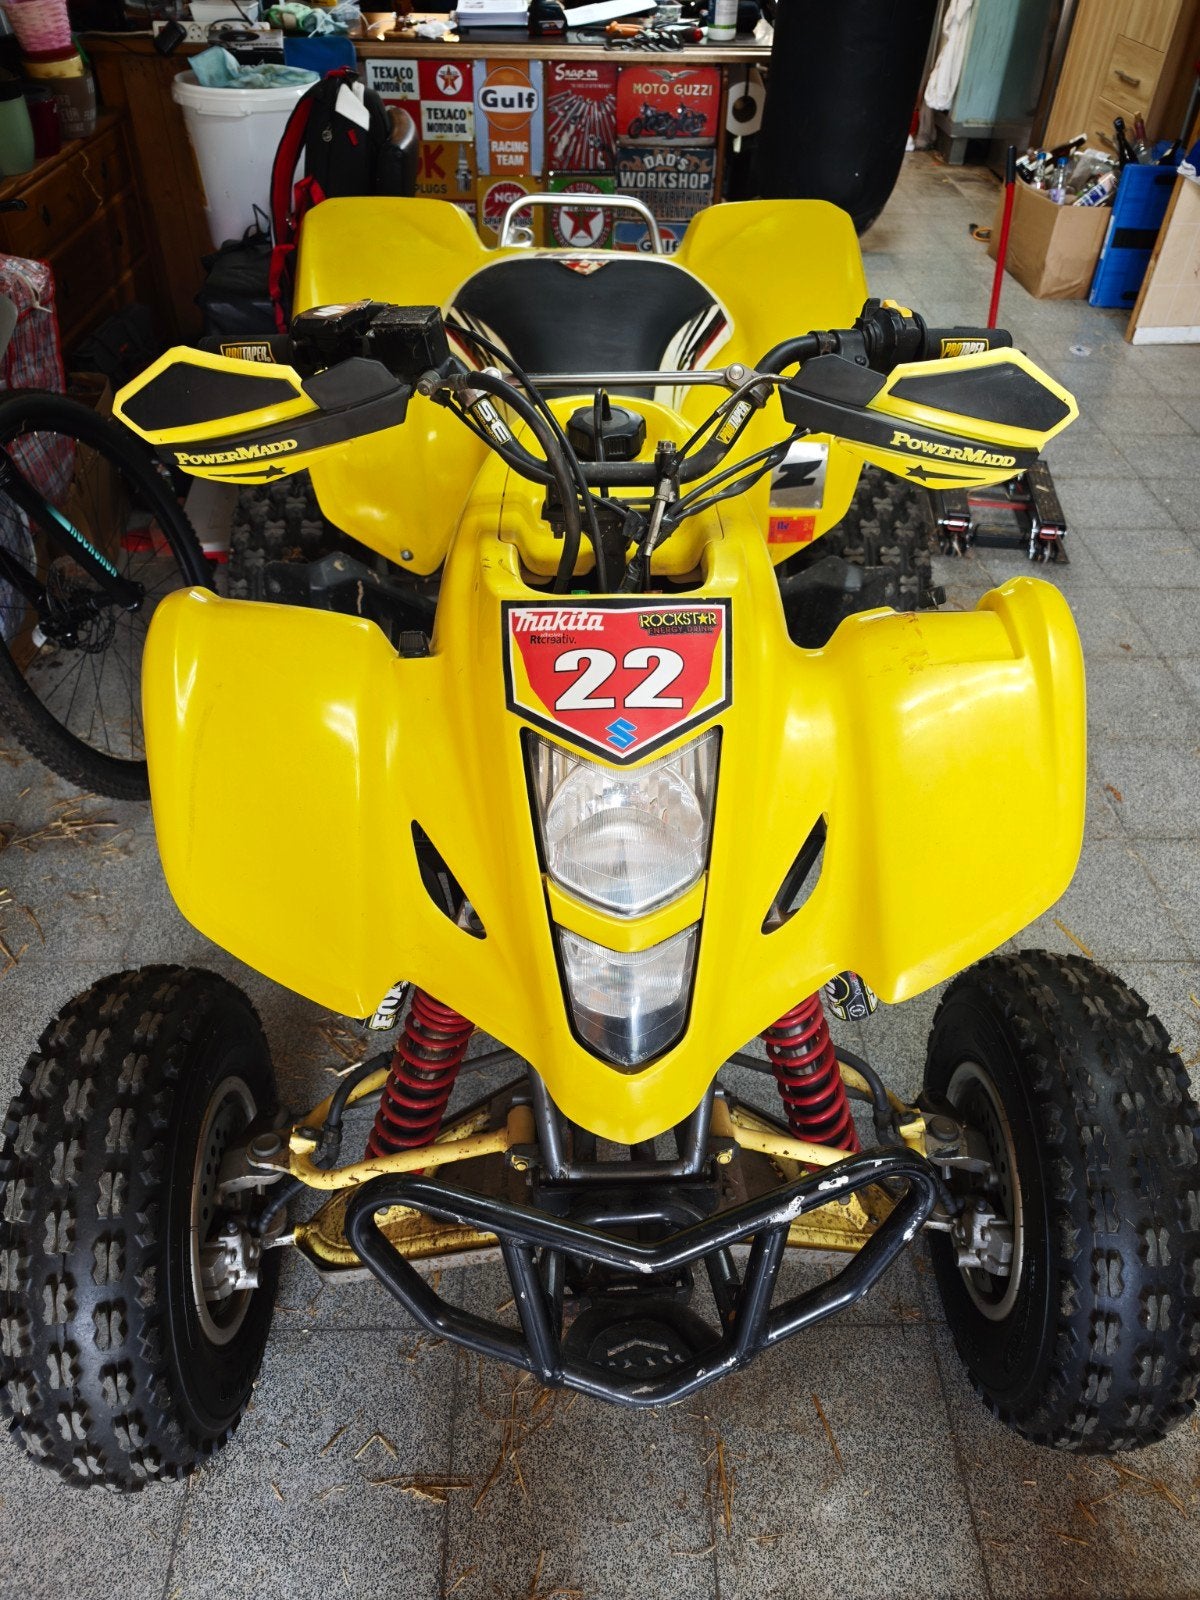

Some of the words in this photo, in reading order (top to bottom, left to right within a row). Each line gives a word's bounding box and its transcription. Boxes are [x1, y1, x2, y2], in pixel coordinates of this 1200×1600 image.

[372, 66, 414, 79] TEXACO
[555, 63, 598, 80] Snap-on
[374, 81, 400, 92] MOTOR
[402, 82, 415, 93] OIL
[633, 83, 670, 95] MOTO
[673, 84, 713, 96] GUZZI
[481, 89, 535, 108] Gulf
[426, 107, 467, 120] TEXACO
[427, 122, 453, 133] MOTOR
[454, 123, 468, 133] OIL
[491, 141, 529, 153] RACING
[496, 154, 525, 166] TEAM
[643, 153, 689, 171] DAD'S
[620, 171, 709, 189] WORKSHOP
[553, 647, 685, 711] 22
